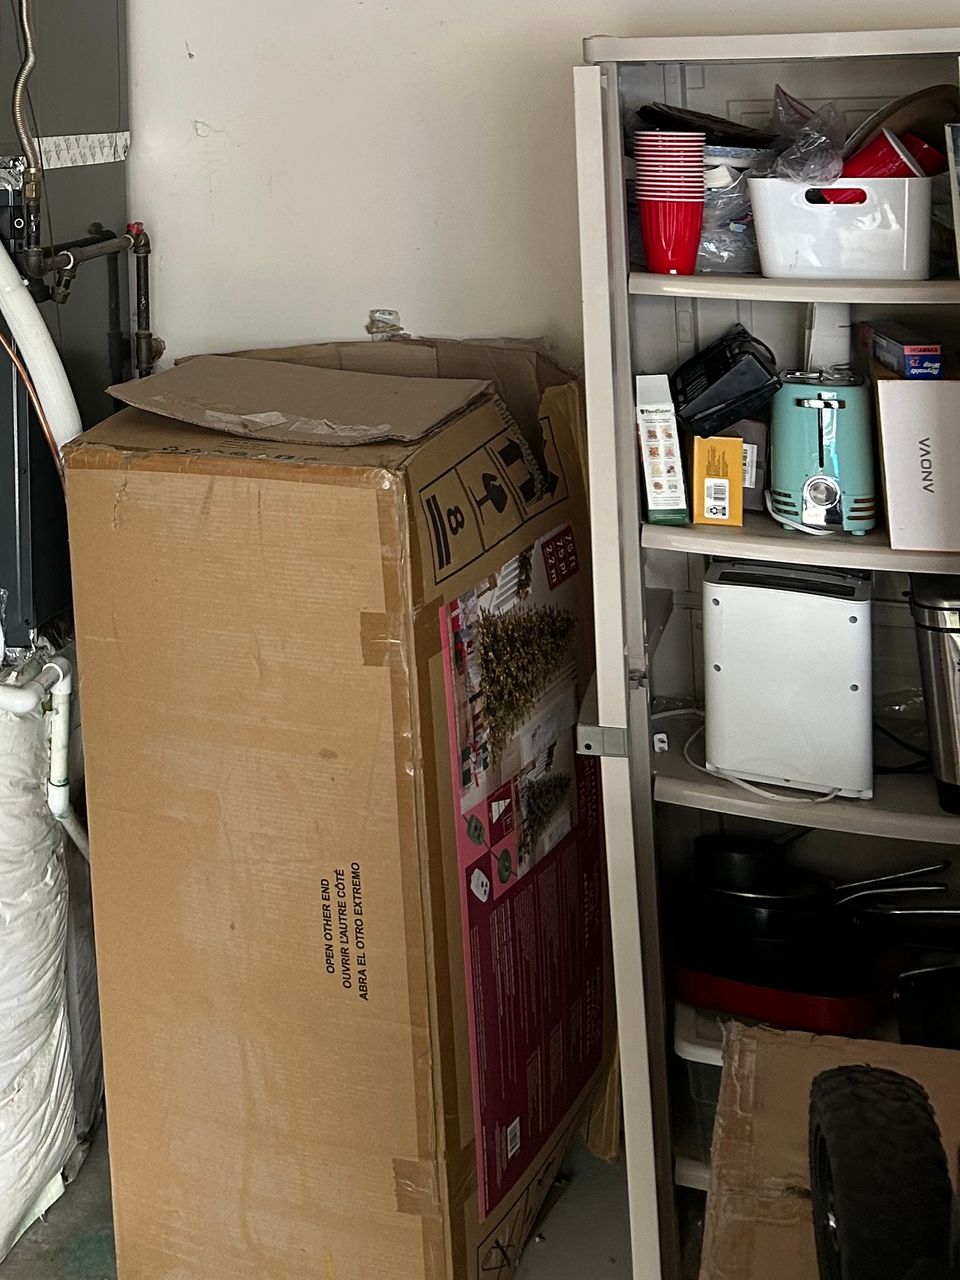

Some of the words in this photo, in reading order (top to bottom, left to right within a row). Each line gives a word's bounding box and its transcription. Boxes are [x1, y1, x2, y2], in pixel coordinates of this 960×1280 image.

[321, 878, 331, 902] END
[333, 869, 346, 898] CÔTÉ
[351, 862, 364, 916] EXTREMO
[323, 903, 333, 941] OTHER
[337, 900, 350, 944] L'AUTRE
[353, 918, 365, 950] OTRO
[326, 943, 335, 974] OPEN
[341, 947, 352, 989] OUVRIR
[356, 952, 366, 966] EL
[359, 968, 369, 1001] ABRA
